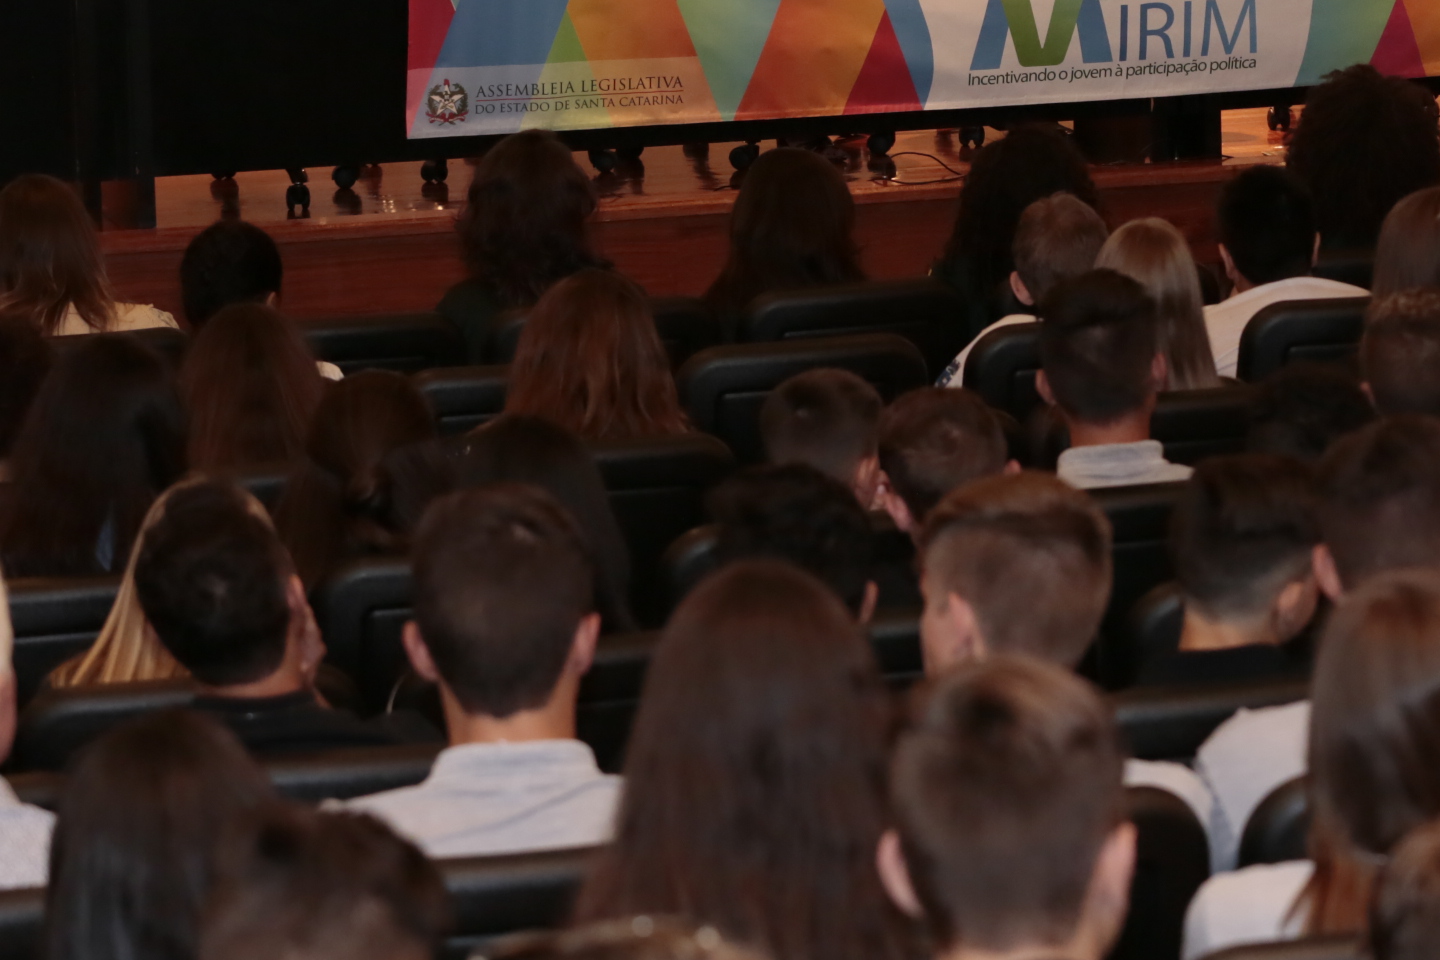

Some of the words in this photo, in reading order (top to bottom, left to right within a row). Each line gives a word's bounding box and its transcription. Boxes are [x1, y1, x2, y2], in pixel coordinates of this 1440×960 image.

[968, 68, 1057, 87] Incentivando
[1058, 70, 1068, 80] o
[1068, 67, 1112, 83] jovem
[1114, 64, 1123, 77] à
[1125, 61, 1207, 79] participação
[1209, 58, 1257, 76] política
[476, 81, 575, 97] ASSEMBLEIA
[581, 76, 684, 93] LEGISLATIVA
[475, 103, 496, 115] DO
[500, 101, 550, 113] ESTADO
[554, 99, 571, 111] DE
[574, 97, 616, 110] SANTA
[619, 94, 684, 108] CATARINA
